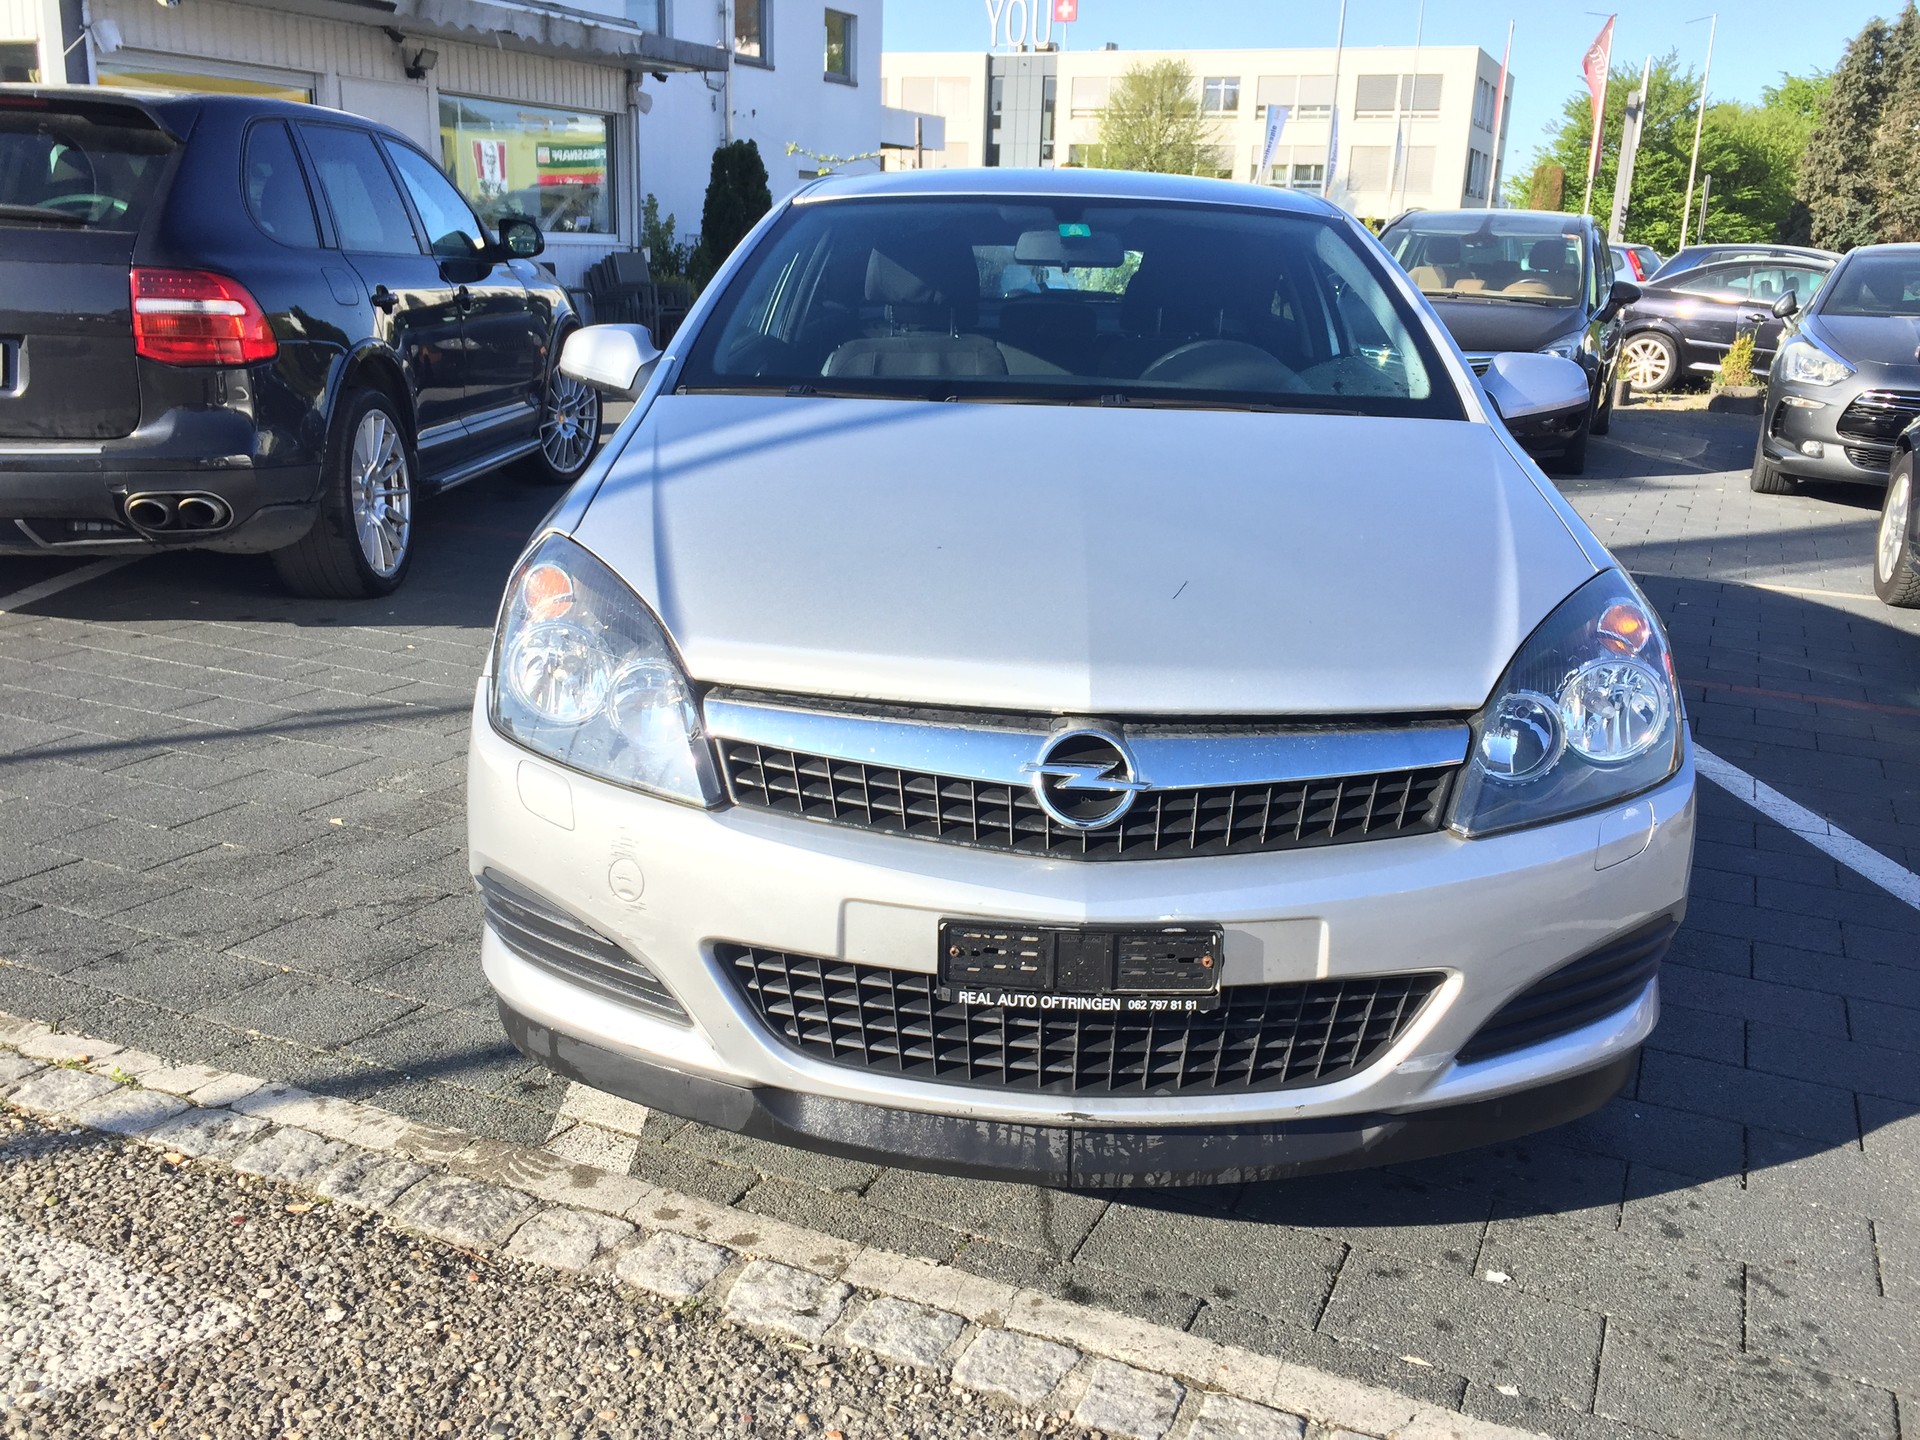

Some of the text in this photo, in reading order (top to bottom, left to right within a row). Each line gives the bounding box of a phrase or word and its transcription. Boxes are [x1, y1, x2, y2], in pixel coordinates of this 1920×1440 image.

[985, 0, 1053, 50] YOU
[958, 991, 1197, 1011] REAL AUTO OFTRINGEN 062 797 81 81
